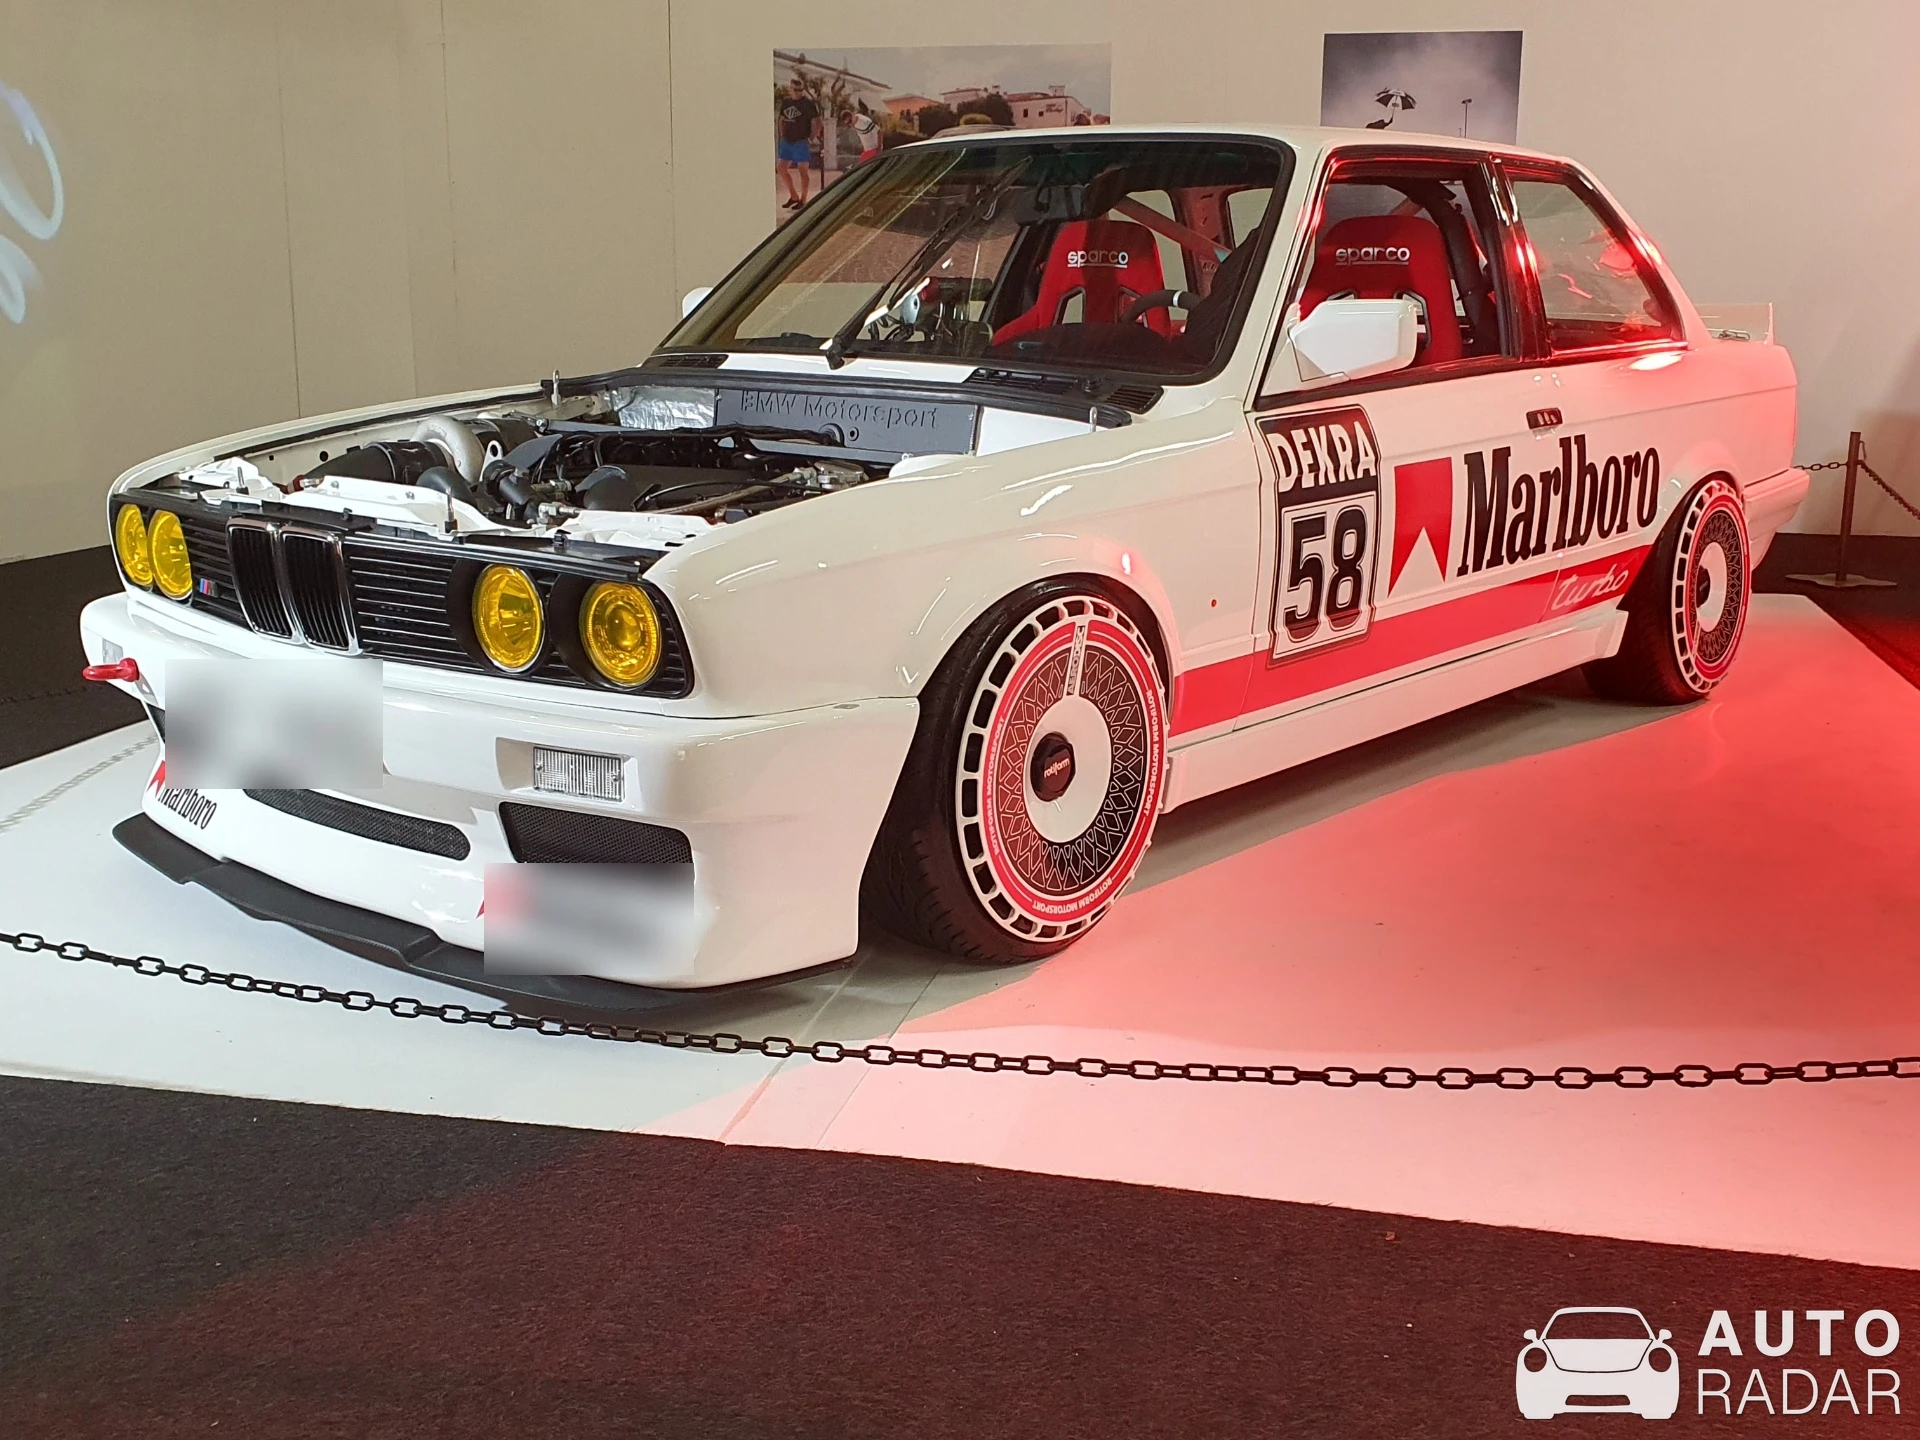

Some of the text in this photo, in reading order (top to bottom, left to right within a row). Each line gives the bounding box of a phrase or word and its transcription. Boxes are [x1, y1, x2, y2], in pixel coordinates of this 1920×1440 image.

[1067, 249, 1129, 268] sparco
[1335, 246, 1410, 266] sparco
[741, 390, 939, 429] BMW Motorsport
[1266, 421, 1377, 493] DEKRA
[1457, 434, 1660, 578] Marlboro
[1283, 504, 1368, 644] 58
[1551, 564, 1629, 611] turbo
[986, 714, 1005, 800] MOTORSPORT
[1043, 757, 1071, 779] rotiform
[1143, 689, 1160, 817] ROTIFORM MOTORSPORT
[1032, 876, 1113, 915] ROTIFORM MOTORSPORT
